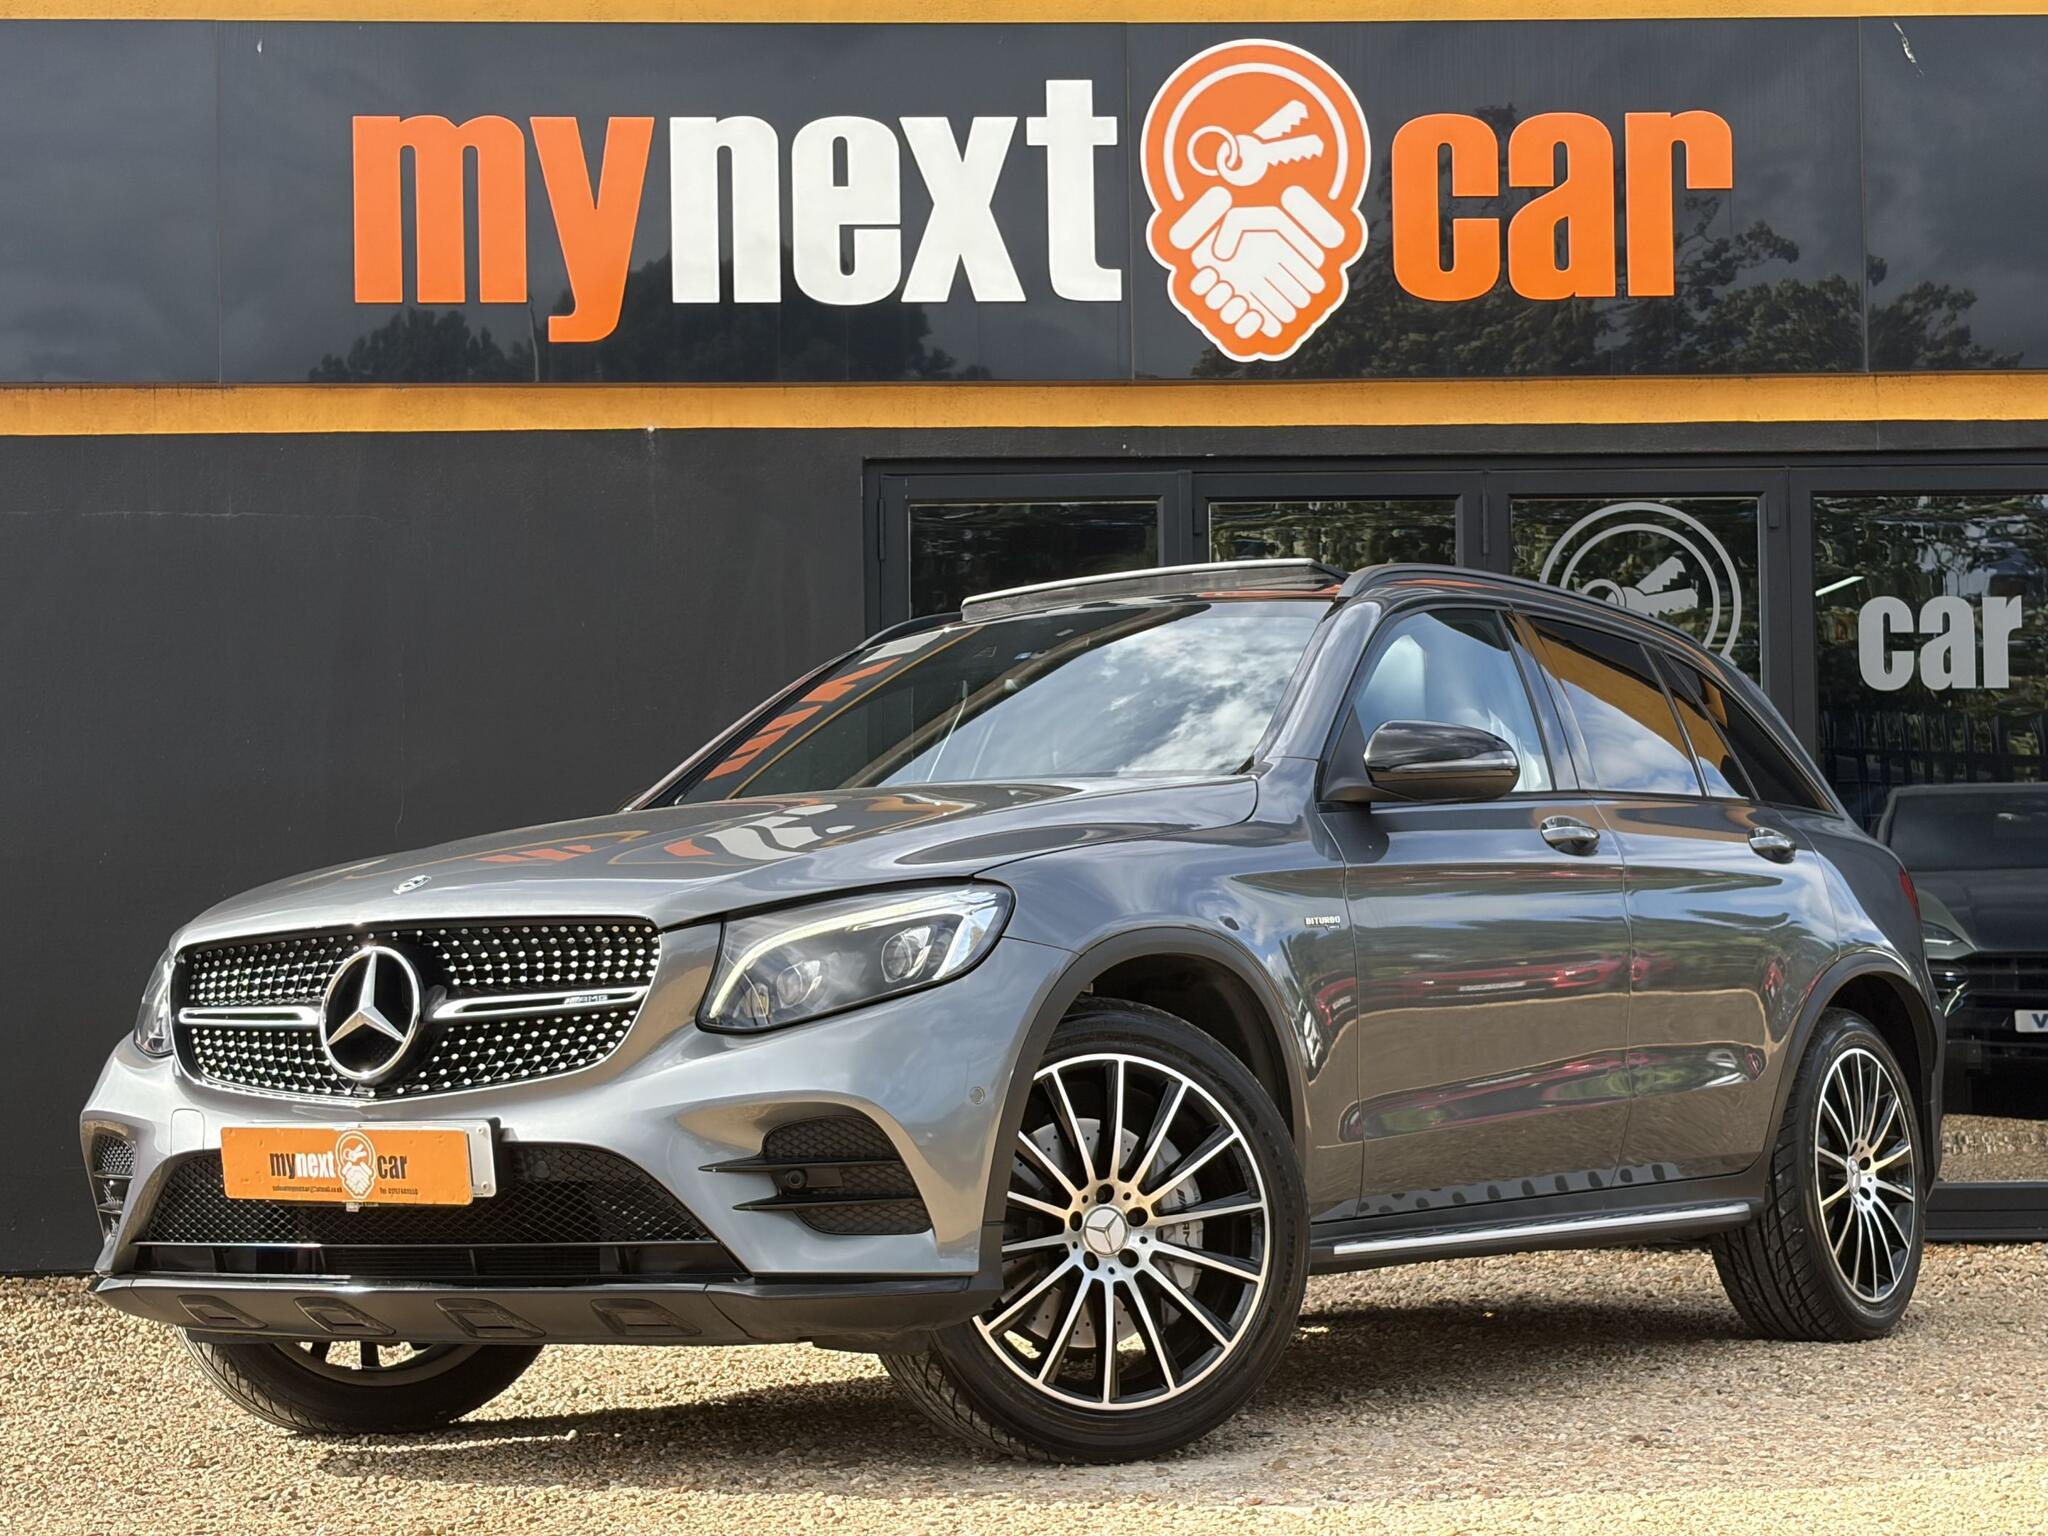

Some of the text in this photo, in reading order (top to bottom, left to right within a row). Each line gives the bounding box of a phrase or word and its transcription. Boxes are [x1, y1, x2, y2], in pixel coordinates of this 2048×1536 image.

[1391, 110, 1734, 302] car
[1857, 594, 2023, 692] car
[1305, 915, 1341, 926] BITURBO
[376, 1153, 408, 1180] car
